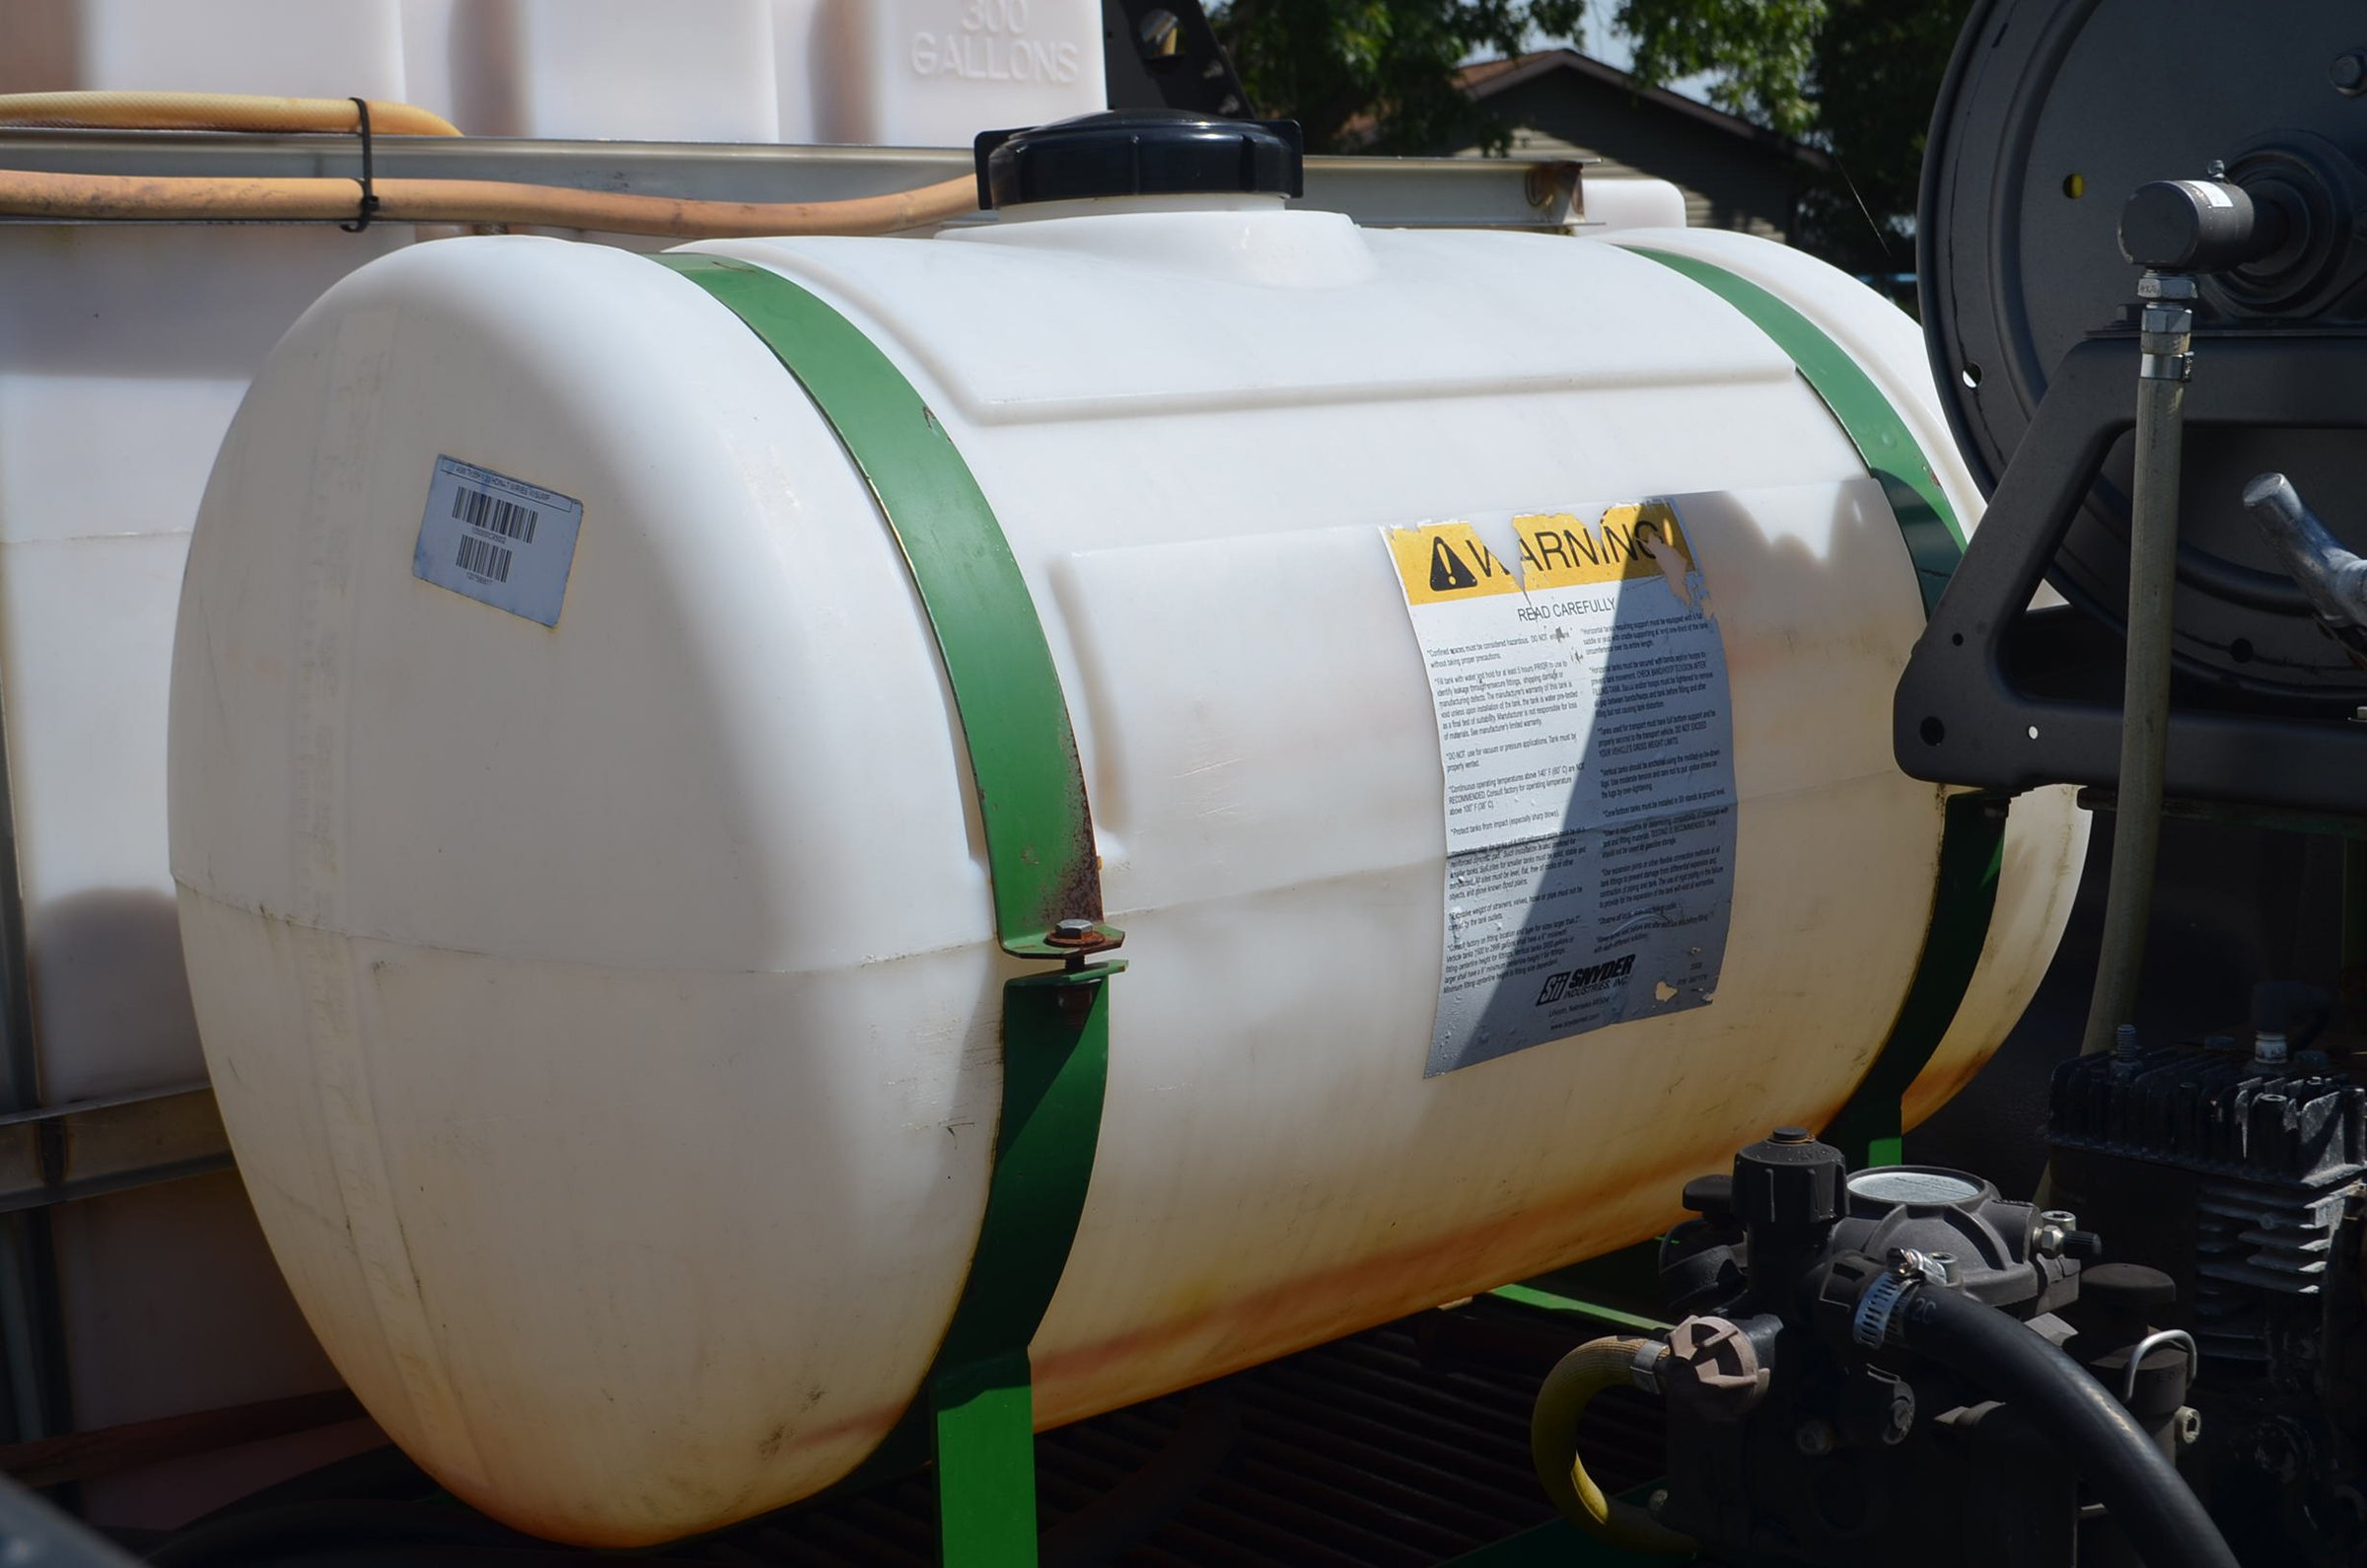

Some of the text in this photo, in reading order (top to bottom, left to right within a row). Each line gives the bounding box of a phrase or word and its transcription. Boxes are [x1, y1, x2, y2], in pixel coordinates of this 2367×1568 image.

[911, 32, 1079, 83] GALLONS
[1518, 598, 1615, 622] READ CAREFULLY
[1569, 954, 1636, 988] SNYDER
